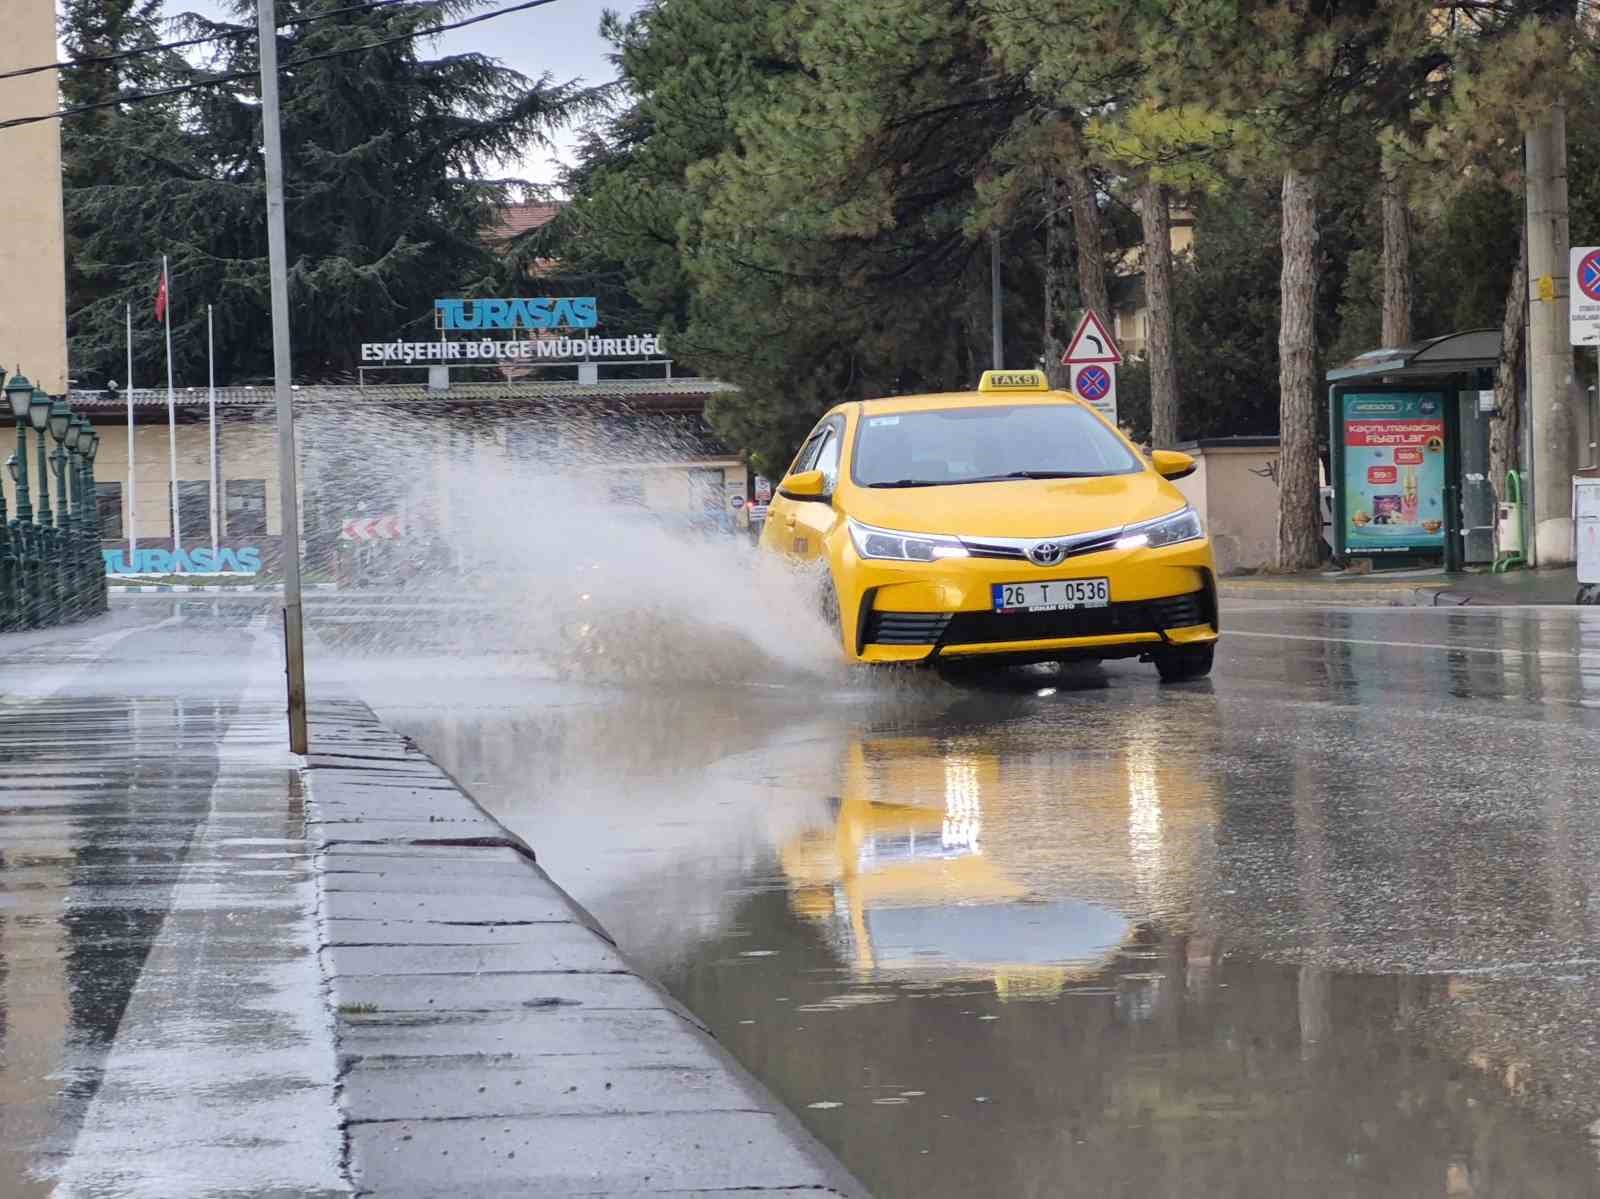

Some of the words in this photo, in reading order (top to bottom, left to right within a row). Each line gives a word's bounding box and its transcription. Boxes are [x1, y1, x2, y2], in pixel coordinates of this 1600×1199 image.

[361, 338, 460, 363] ESKİŞEHİR
[466, 337, 531, 360] BÖLGE
[1005, 586, 1025, 605] 26
[1040, 585, 1049, 602] T
[1065, 582, 1106, 601] 0536
